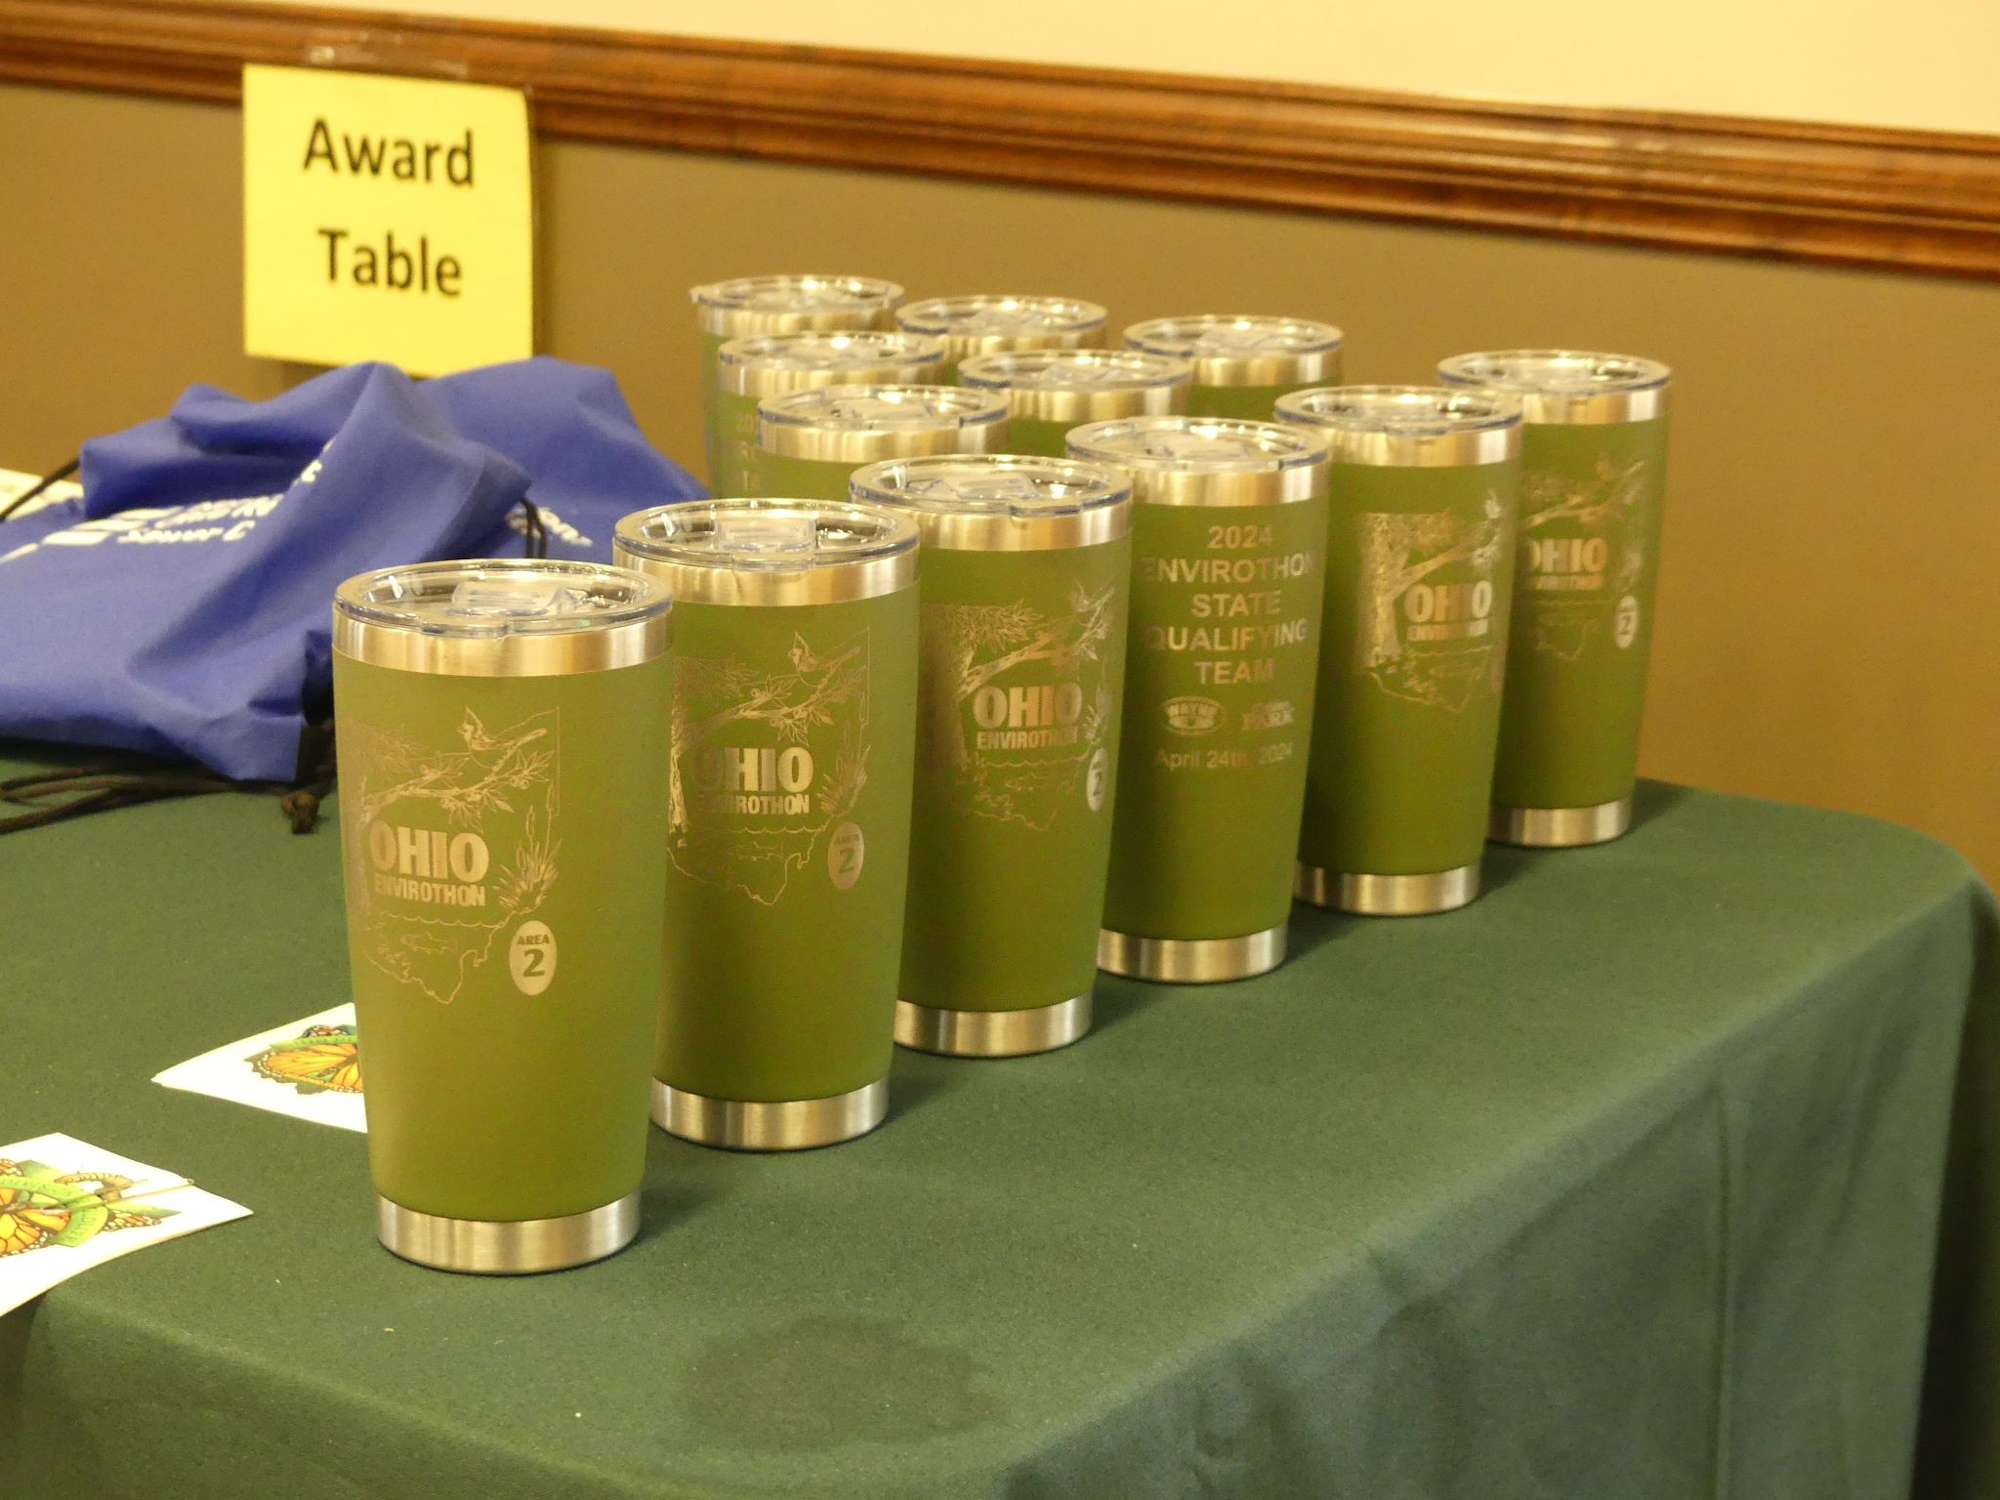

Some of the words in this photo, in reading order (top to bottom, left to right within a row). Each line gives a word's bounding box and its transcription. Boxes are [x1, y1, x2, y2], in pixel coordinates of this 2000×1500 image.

[303, 117, 475, 187] Award
[318, 227, 463, 298] Table
[1206, 524, 1274, 549] 2024
[1191, 590, 1282, 618] STATE
[1194, 659, 1274, 685] TEAM
[973, 682, 1082, 729] OHIO
[976, 726, 1078, 750] ENVIROTN
[1156, 748, 1200, 772] April
[700, 794, 810, 815] IROTHON
[369, 820, 489, 883] OHIO
[837, 848, 855, 874] 2
[374, 872, 486, 907] ENVIROTHON
[516, 934, 550, 946] AREA
[522, 949, 545, 978] 2
